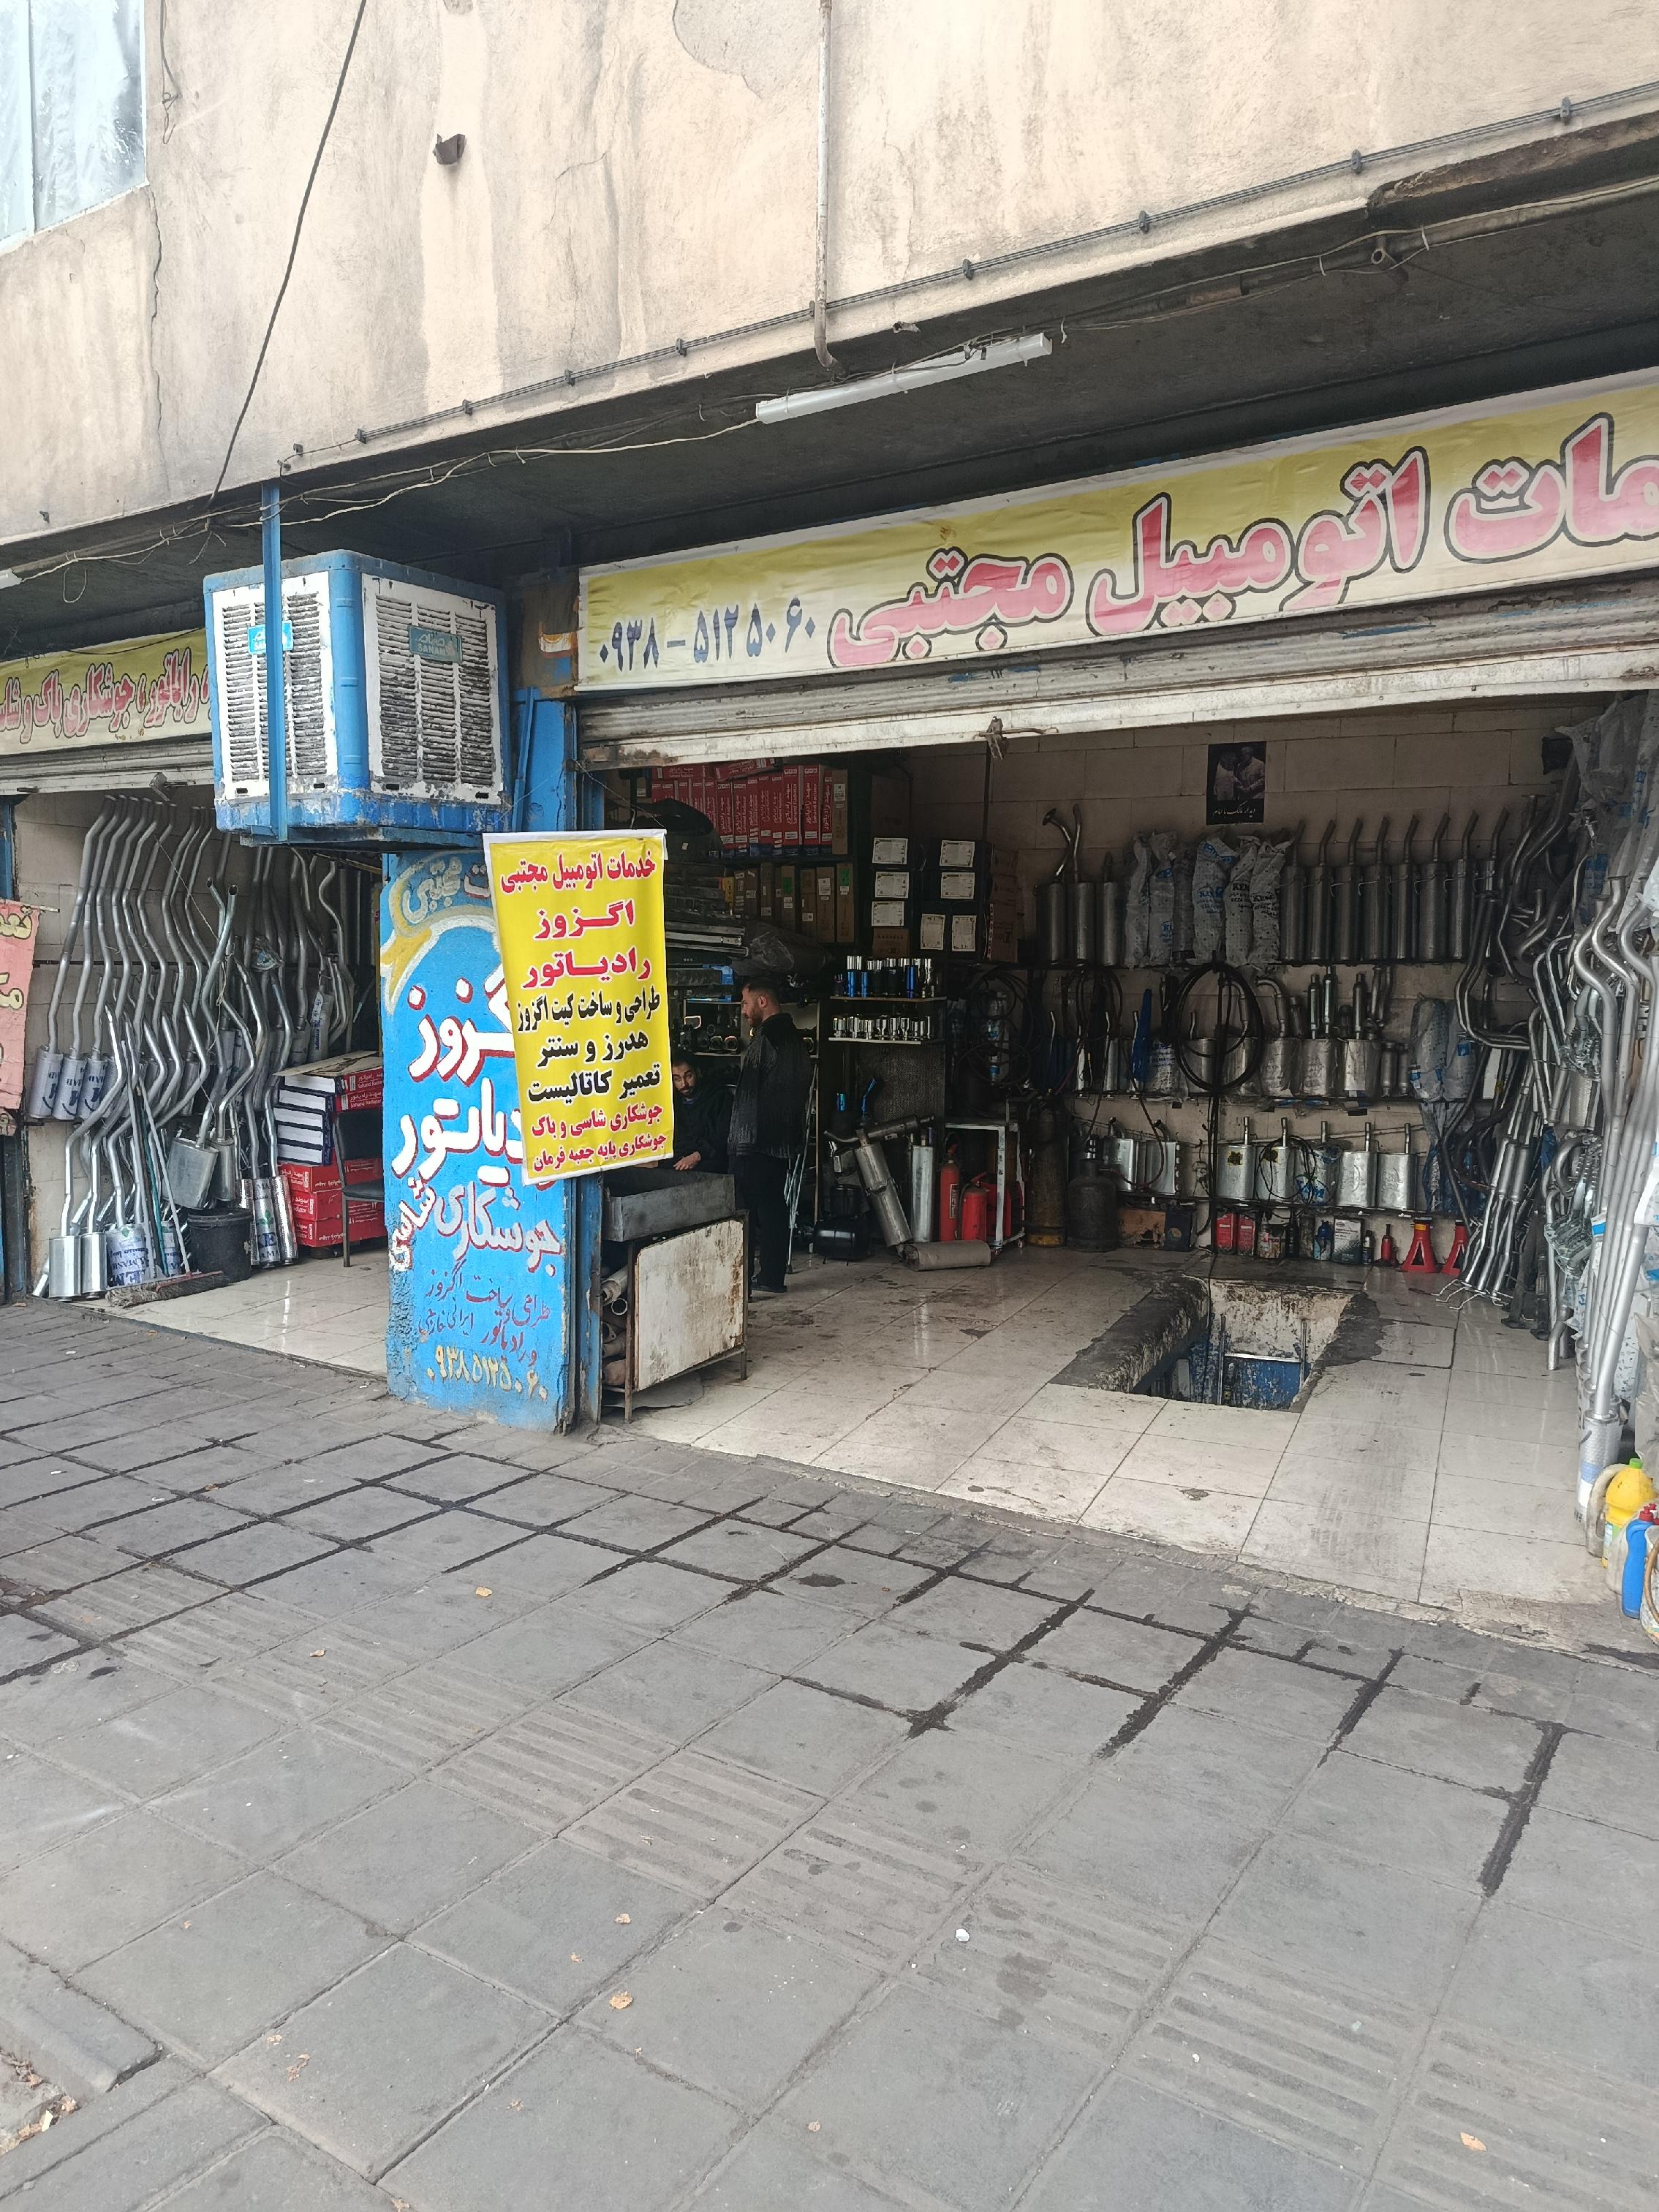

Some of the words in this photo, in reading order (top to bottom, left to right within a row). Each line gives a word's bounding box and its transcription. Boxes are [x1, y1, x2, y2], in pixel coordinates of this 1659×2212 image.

[1444, 412, 1659, 565] مات
[1087, 446, 1431, 636] اتومبیل
[827, 546, 1074, 667] مجتبی
[33, 669, 63, 739] باک
[62, 662, 136, 738] جوشکاری
[20, 695, 33, 744] و
[501, 860, 548, 893] مجتبی
[553, 852, 603, 890] اتومبیل
[607, 850, 656, 880] خدمات
[534, 899, 635, 940] اگزوز
[522, 946, 651, 989] رادیاتور
[518, 994, 548, 1032] اگزوز
[551, 992, 574, 1025] کیت
[578, 990, 613, 1019] ساخت
[616, 1001, 622, 1024] و
[624, 986, 660, 1023] طراحی
[408, 964, 515, 1088] گزوز
[537, 1036, 578, 1068] سنتر
[585, 1040, 596, 1062] و
[602, 1031, 649, 1061] هدرز
[528, 1070, 613, 1104] کاتالیست
[619, 1062, 660, 1100] تعمیر
[532, 1115, 556, 1138] باک
[560, 1121, 567, 1139] و
[570, 1110, 607, 1136] شاسی
[611, 1103, 662, 1132] جوشکاری
[534, 1146, 566, 1171] فرمان
[569, 1147, 594, 1164] جعبه
[597, 1141, 617, 1160] پایه
[619, 1133, 667, 1157] جوشکاری
[434, 1181, 562, 1277] جوشکاری
[425, 1258, 467, 1302] اگزوز
[466, 1275, 513, 1309] ساخت
[512, 1294, 551, 1328] طراحی
